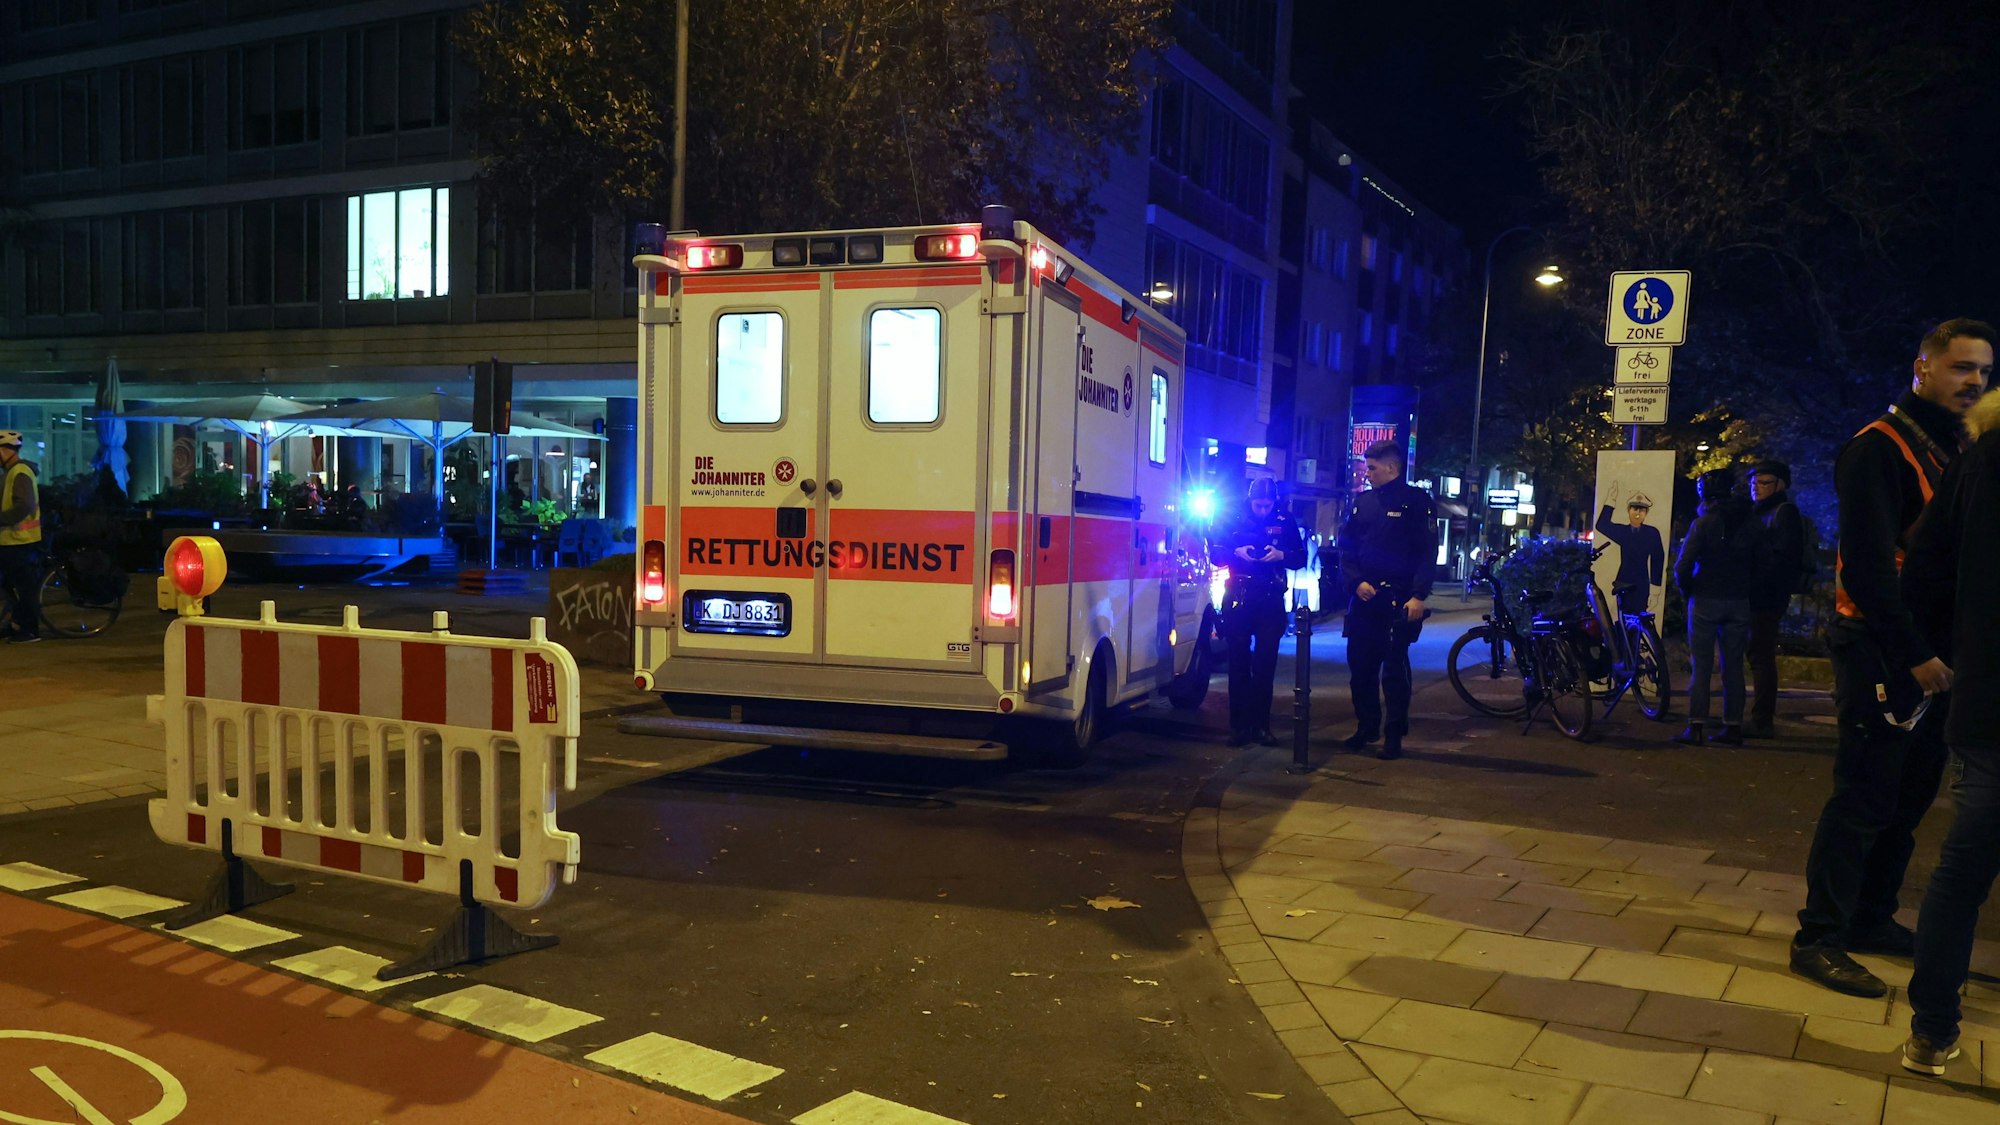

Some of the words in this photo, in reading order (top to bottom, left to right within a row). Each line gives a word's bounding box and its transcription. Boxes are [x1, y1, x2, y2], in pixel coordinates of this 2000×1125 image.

[1626, 328, 1664, 339] ZONE
[1081, 345, 1093, 374] DIE
[1634, 371, 1651, 379] frei
[1079, 375, 1119, 414] JOHANNITER
[1618, 387, 1667, 395] Lieferverkehr
[695, 456, 714, 470] DIE
[691, 471, 765, 486] JOHANNITER
[691, 487, 766, 499] www.johanniter.de
[688, 538, 965, 572] RETTUNGSDIENST
[702, 602, 712, 619] K
[722, 603, 741, 619] DJ
[745, 604, 782, 622] 8831
